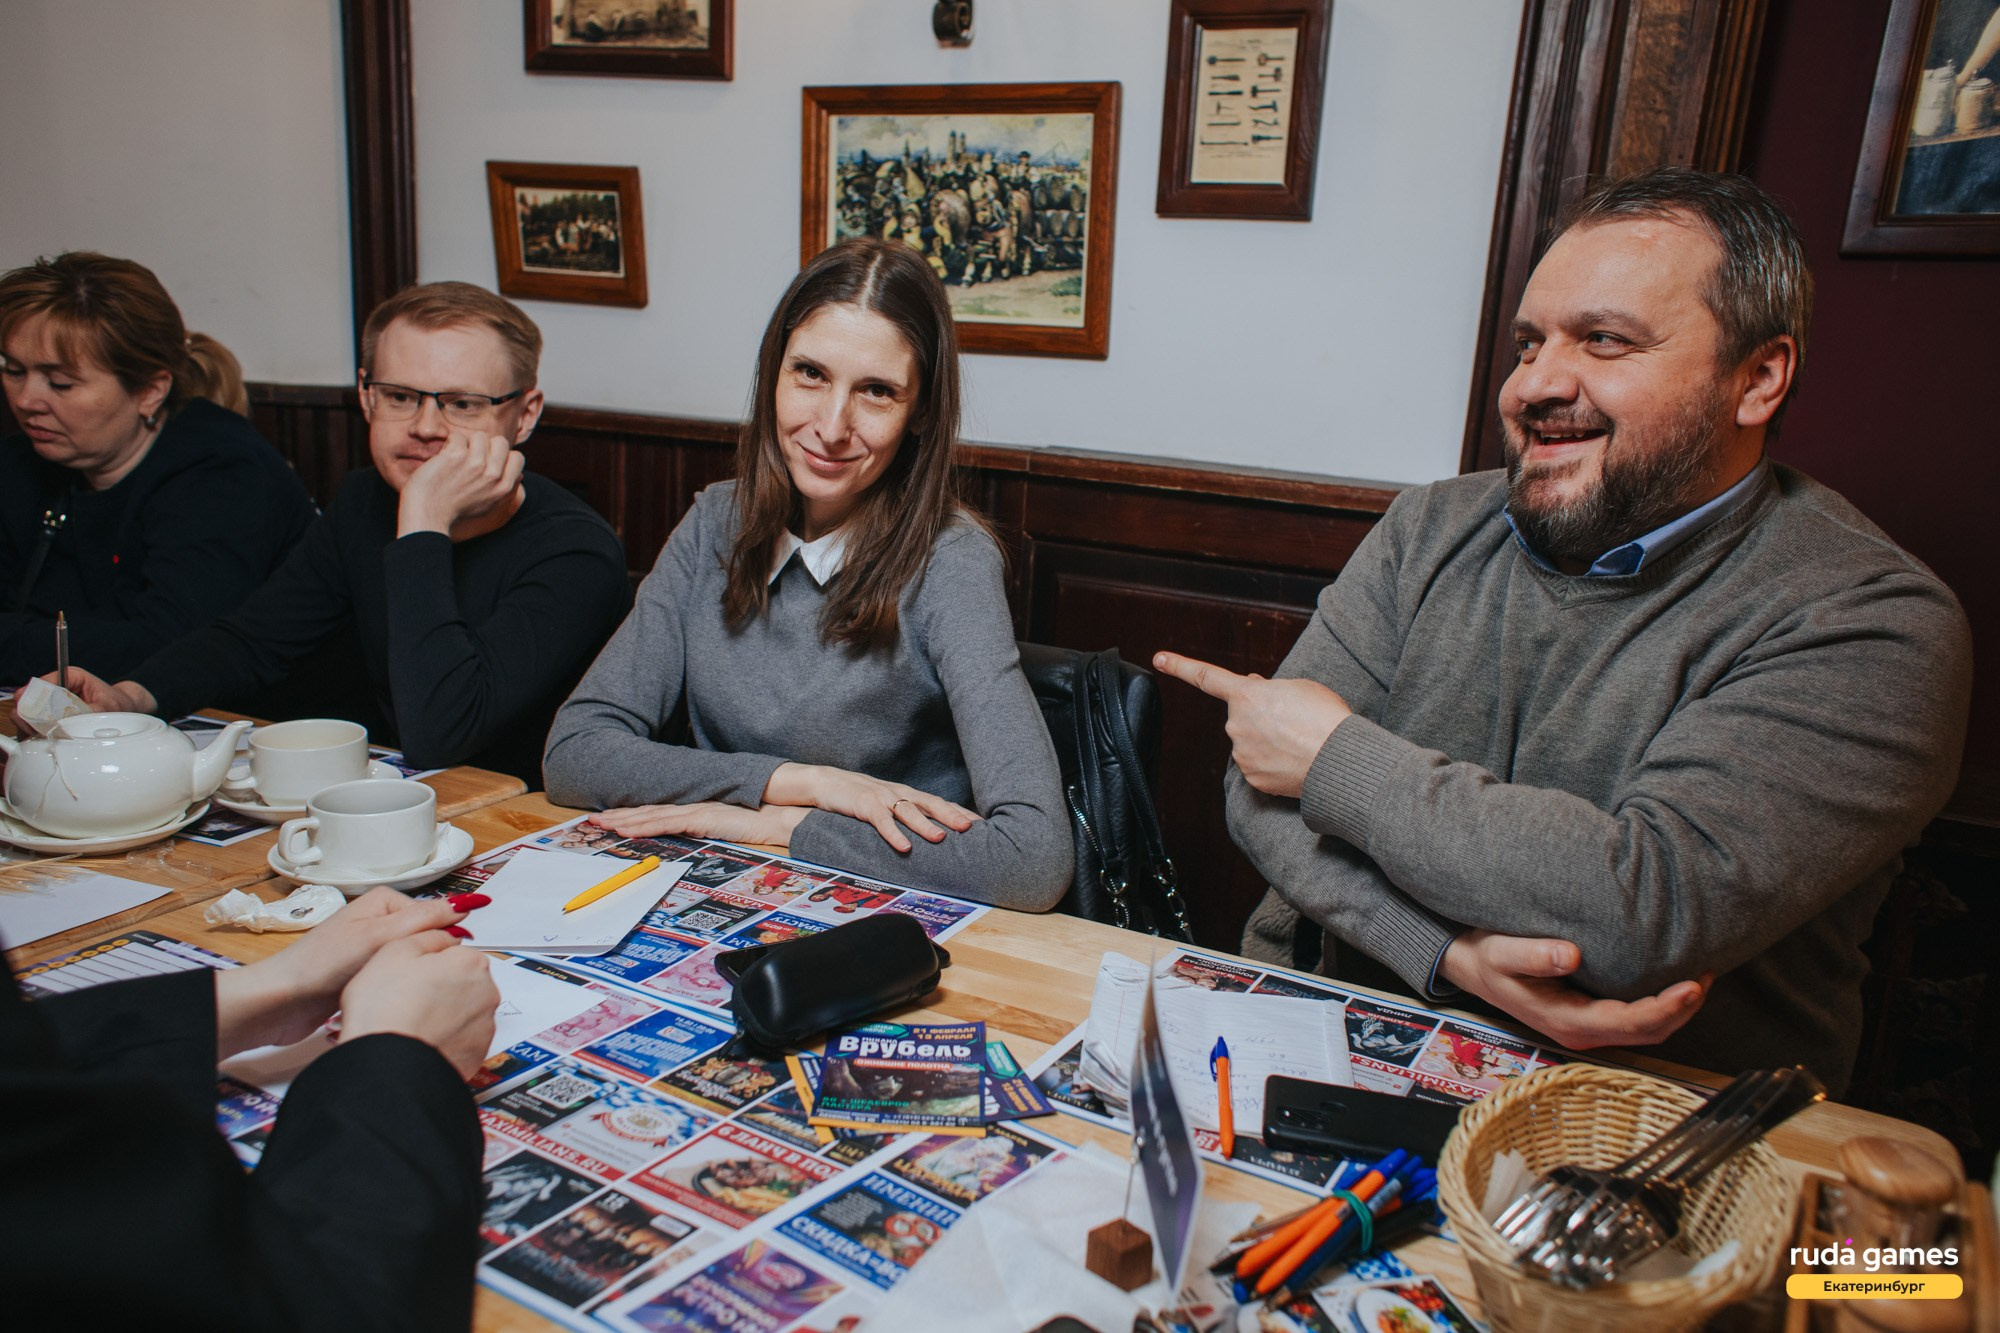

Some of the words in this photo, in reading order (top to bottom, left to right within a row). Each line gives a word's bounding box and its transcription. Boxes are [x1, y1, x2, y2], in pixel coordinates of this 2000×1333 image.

[1376, 1006, 1413, 1018] ЛИНДА
[838, 1035, 972, 1058] Врубель
[857, 1058, 906, 1069] ОЖИВШИЕ
[908, 1061, 951, 1070] ПОЛОТНА
[731, 1132, 788, 1158] ЛАНЧ
